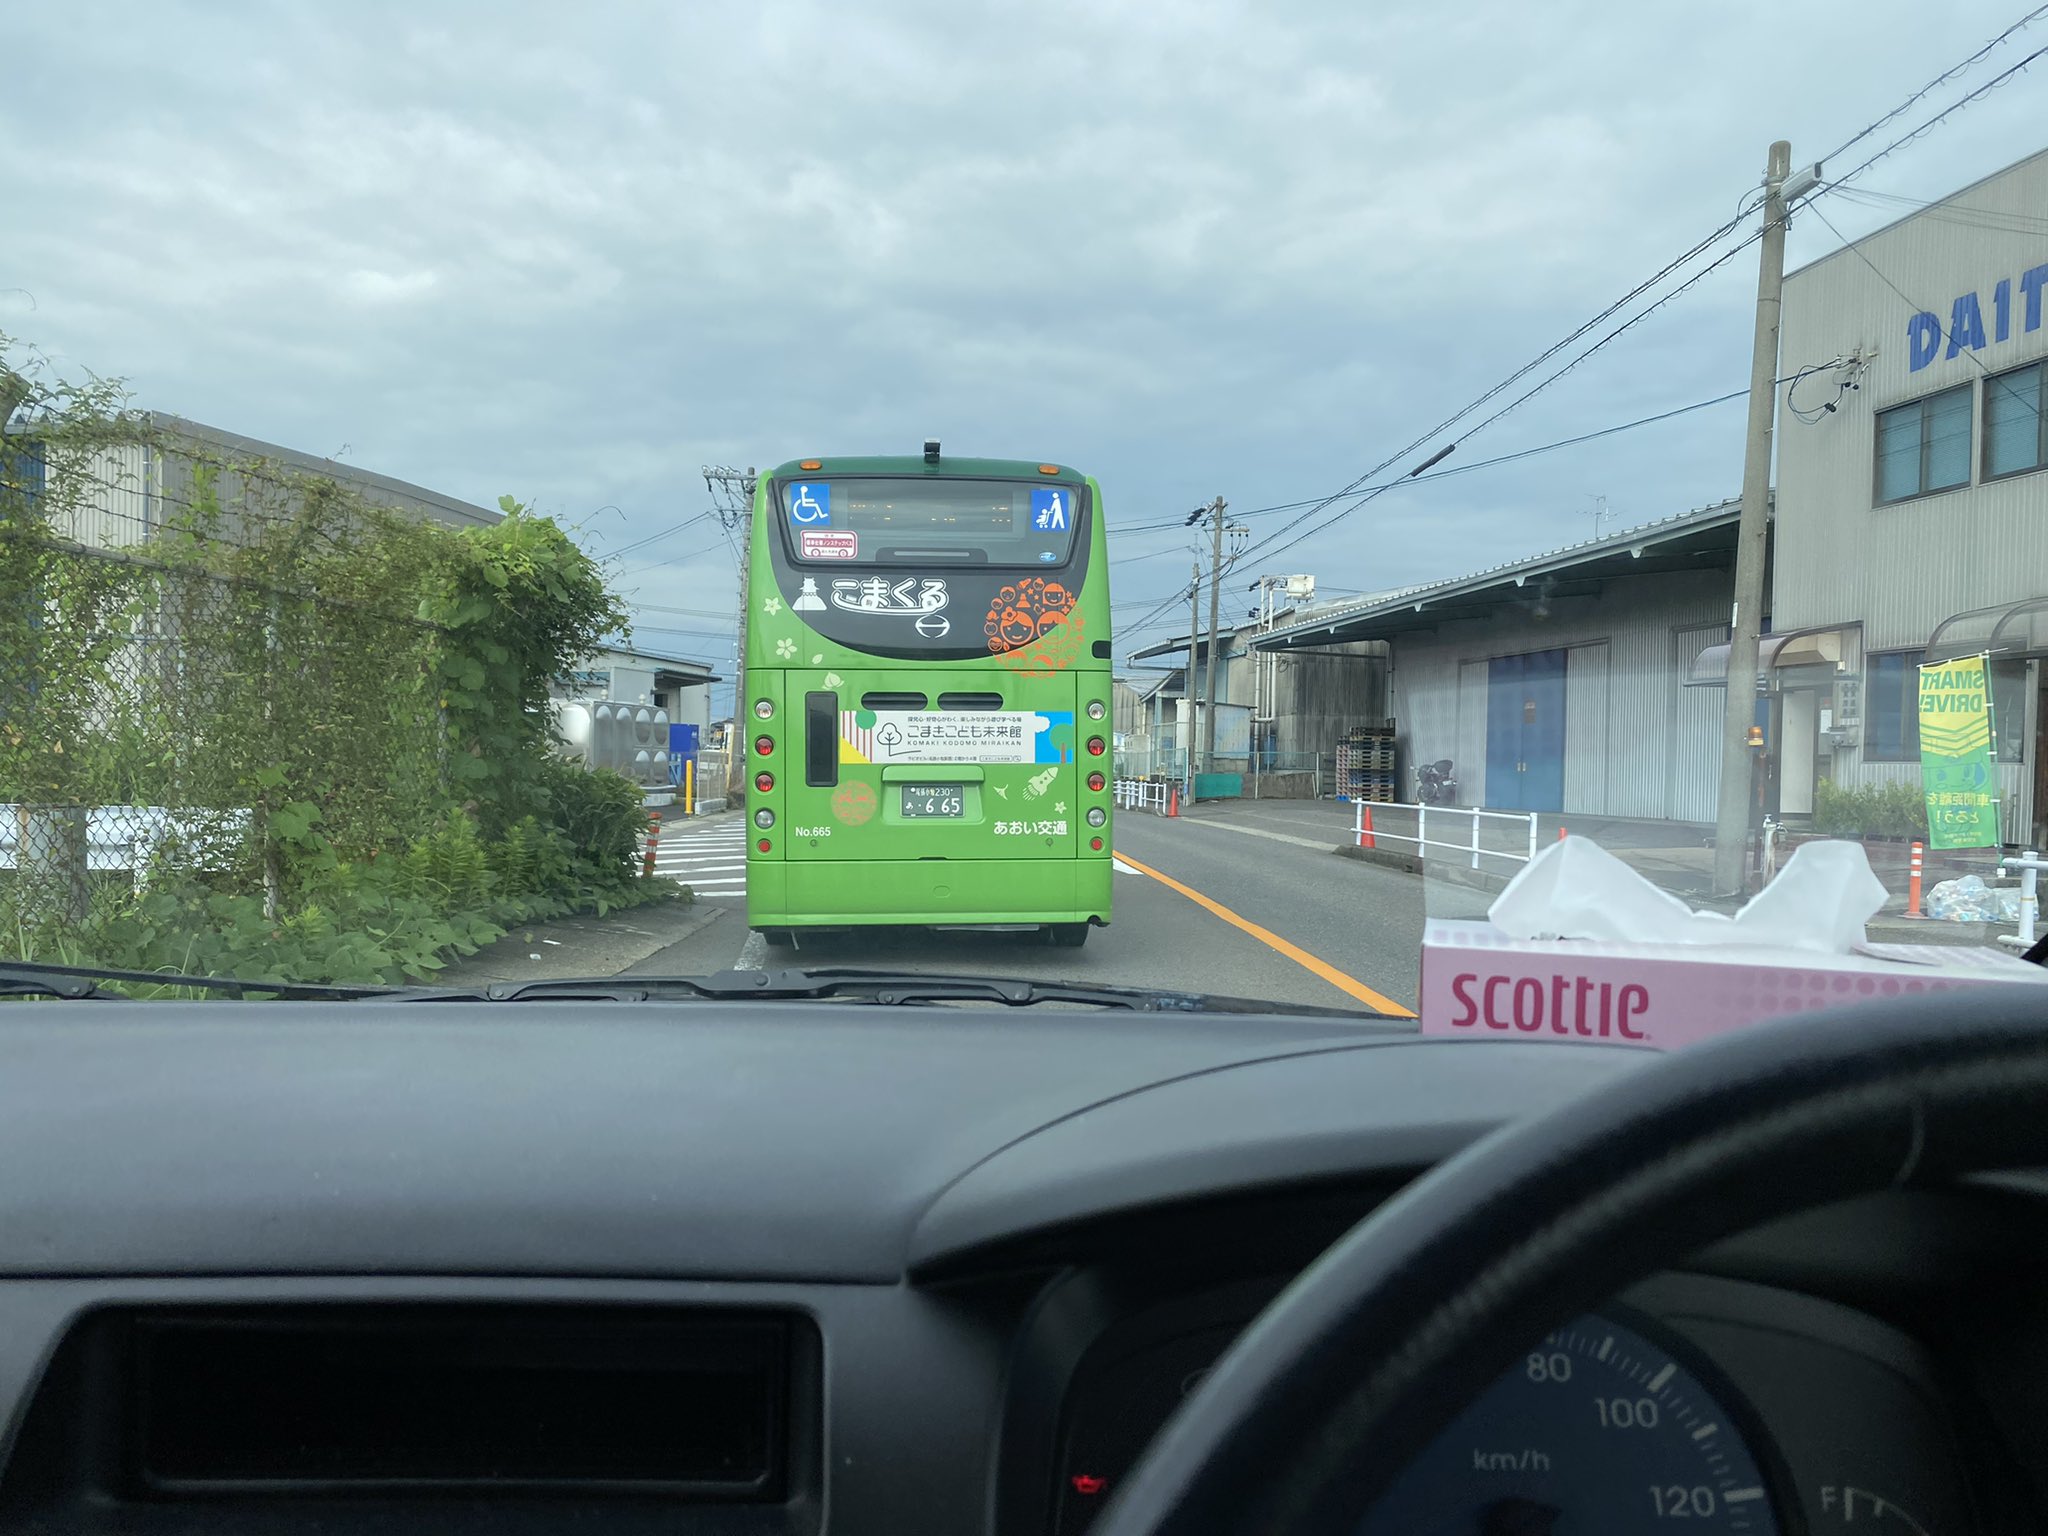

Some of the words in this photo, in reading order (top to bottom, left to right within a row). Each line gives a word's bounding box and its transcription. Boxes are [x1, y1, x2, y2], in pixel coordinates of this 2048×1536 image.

[831, 576, 950, 616] こまくる
[907, 725, 1022, 738] こまきこども未来館
[795, 826, 831, 837] No.665
[993, 820, 1068, 836] あおい交通
[1451, 973, 1649, 1040] scottie
[1526, 1352, 1572, 1383] 80
[1593, 1397, 1660, 1429] 100
[1472, 1446, 1551, 1474] km/h
[1650, 1485, 1716, 1518] 120
[1820, 1485, 1837, 1513] F
